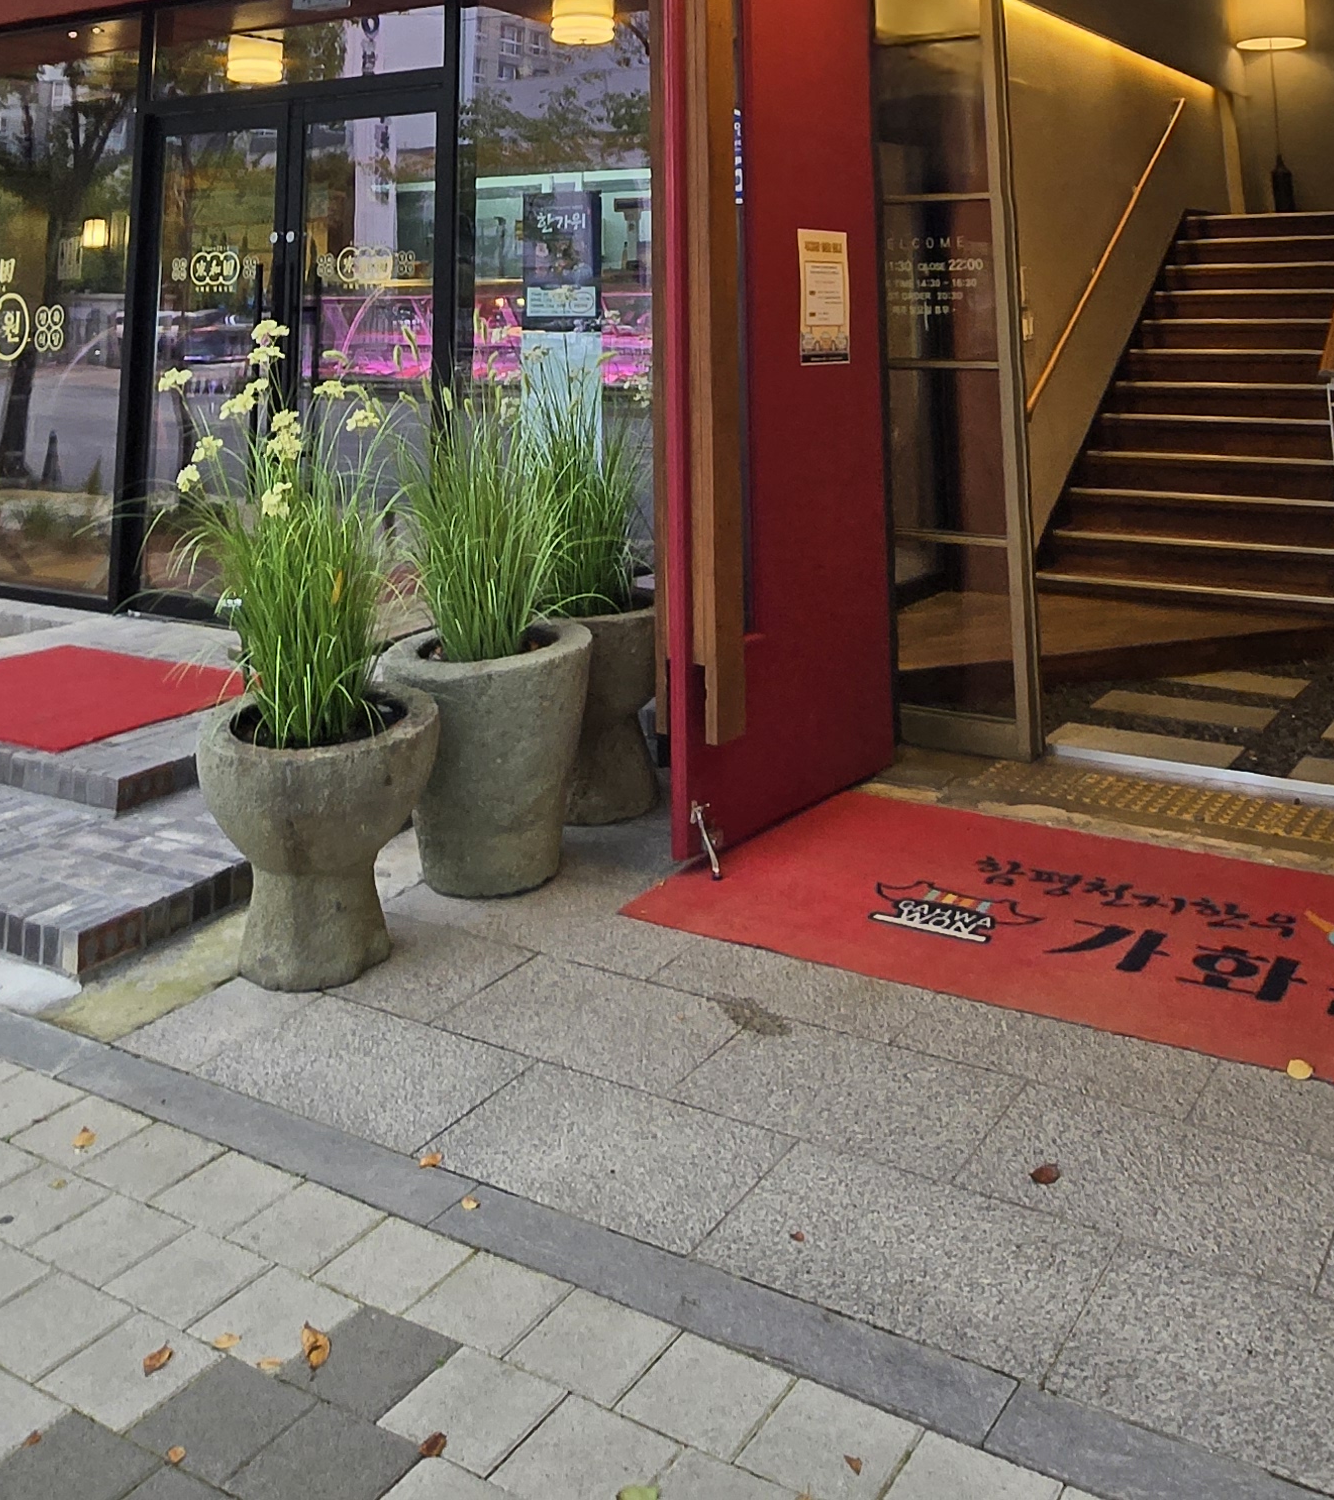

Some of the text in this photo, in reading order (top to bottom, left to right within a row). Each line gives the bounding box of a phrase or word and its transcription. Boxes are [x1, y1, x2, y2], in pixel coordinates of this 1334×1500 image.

[536, 211, 586, 234] 한가위
[887, 235, 965, 250] ELCOME
[948, 258, 984, 271] 22:00
[974, 855, 1298, 939] 함평천지한우
